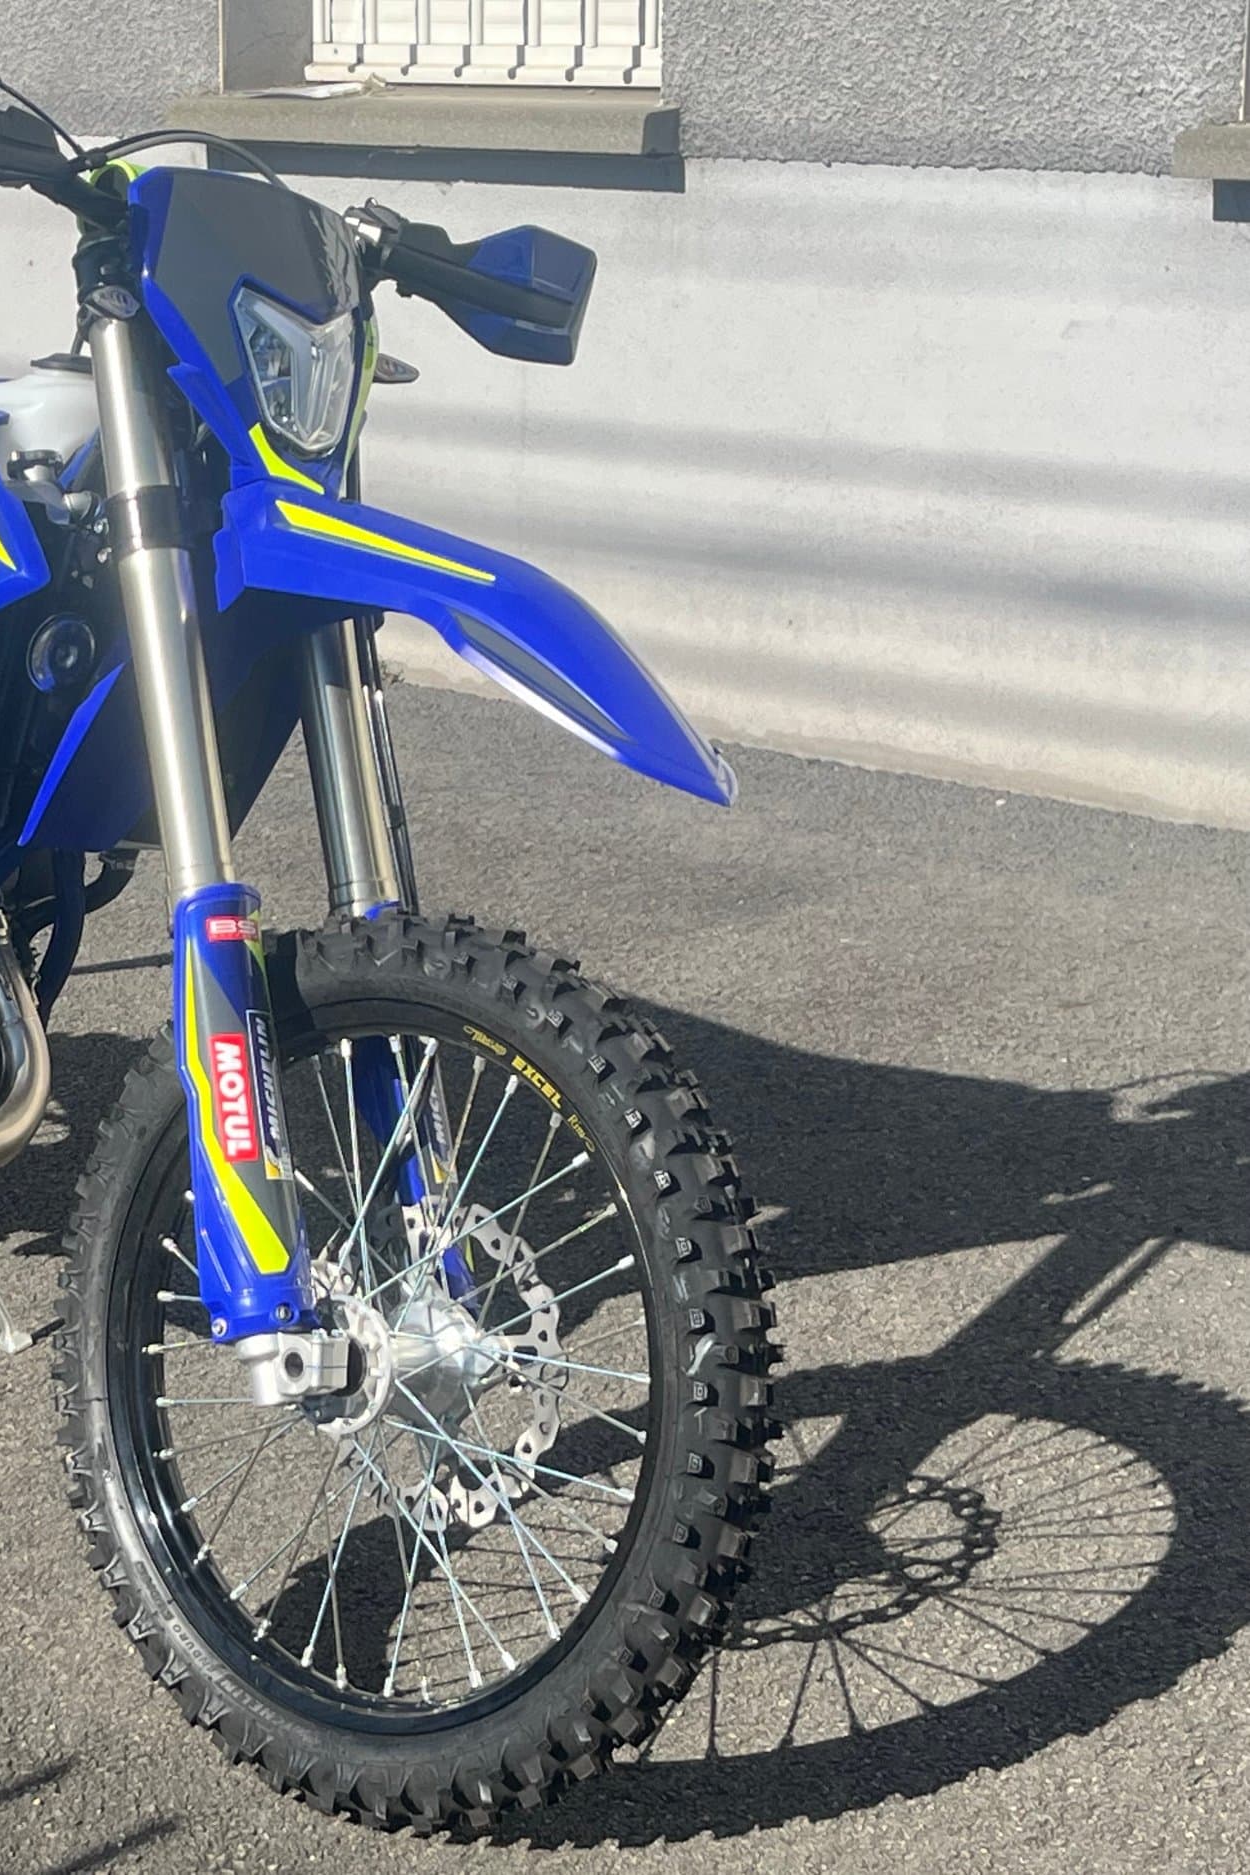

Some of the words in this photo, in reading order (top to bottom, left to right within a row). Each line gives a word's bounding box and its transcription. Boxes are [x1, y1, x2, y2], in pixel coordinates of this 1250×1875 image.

[214, 1041, 251, 1157] MOTUL
[255, 1016, 280, 1141] MICHELIN
[511, 1055, 561, 1109] EXCEL
